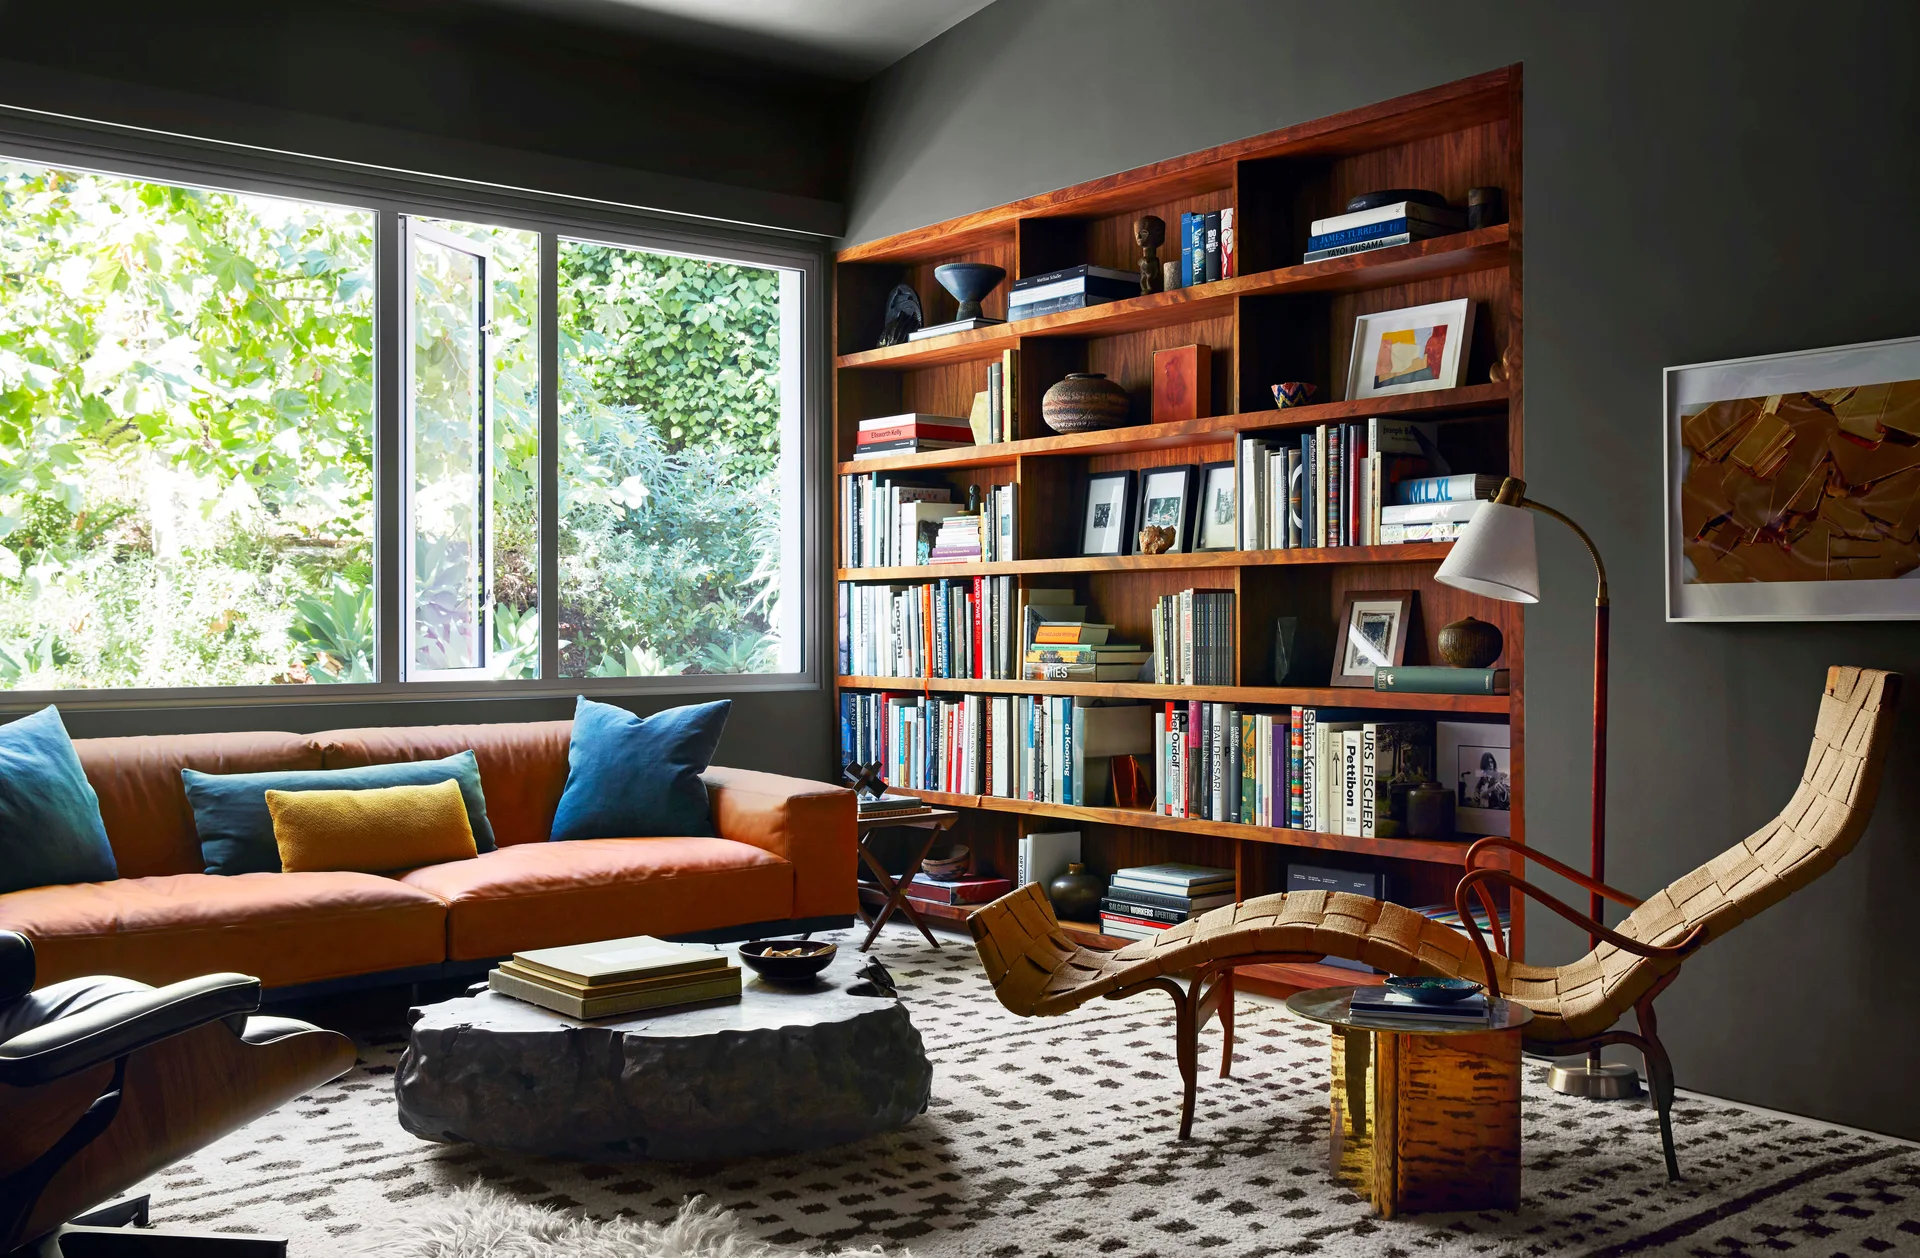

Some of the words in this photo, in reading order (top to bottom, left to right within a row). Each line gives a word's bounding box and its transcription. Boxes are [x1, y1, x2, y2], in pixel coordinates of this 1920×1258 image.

[1194, 228, 1202, 247] Van
[1319, 233, 1345, 244] JAMES
[1346, 224, 1384, 238] TURRELL
[1327, 246, 1348, 258] YAYOI
[1350, 239, 1384, 253] KUSAMA
[870, 430, 891, 439] Ellsworth
[894, 600, 903, 659] noguchi
[1043, 666, 1068, 679] MIES
[1064, 723, 1071, 735] de
[1304, 710, 1315, 752] Shiro
[1171, 732, 1180, 768] Oudolf
[1364, 730, 1374, 760] URS
[1346, 745, 1357, 807] Pettibon
[1304, 755, 1315, 829] Kuramata
[1362, 764, 1374, 829] FISCHER
[1108, 902, 1130, 913] SALGADO
[1130, 905, 1154, 917] WORKERS
[1154, 909, 1179, 921] APERTURE
